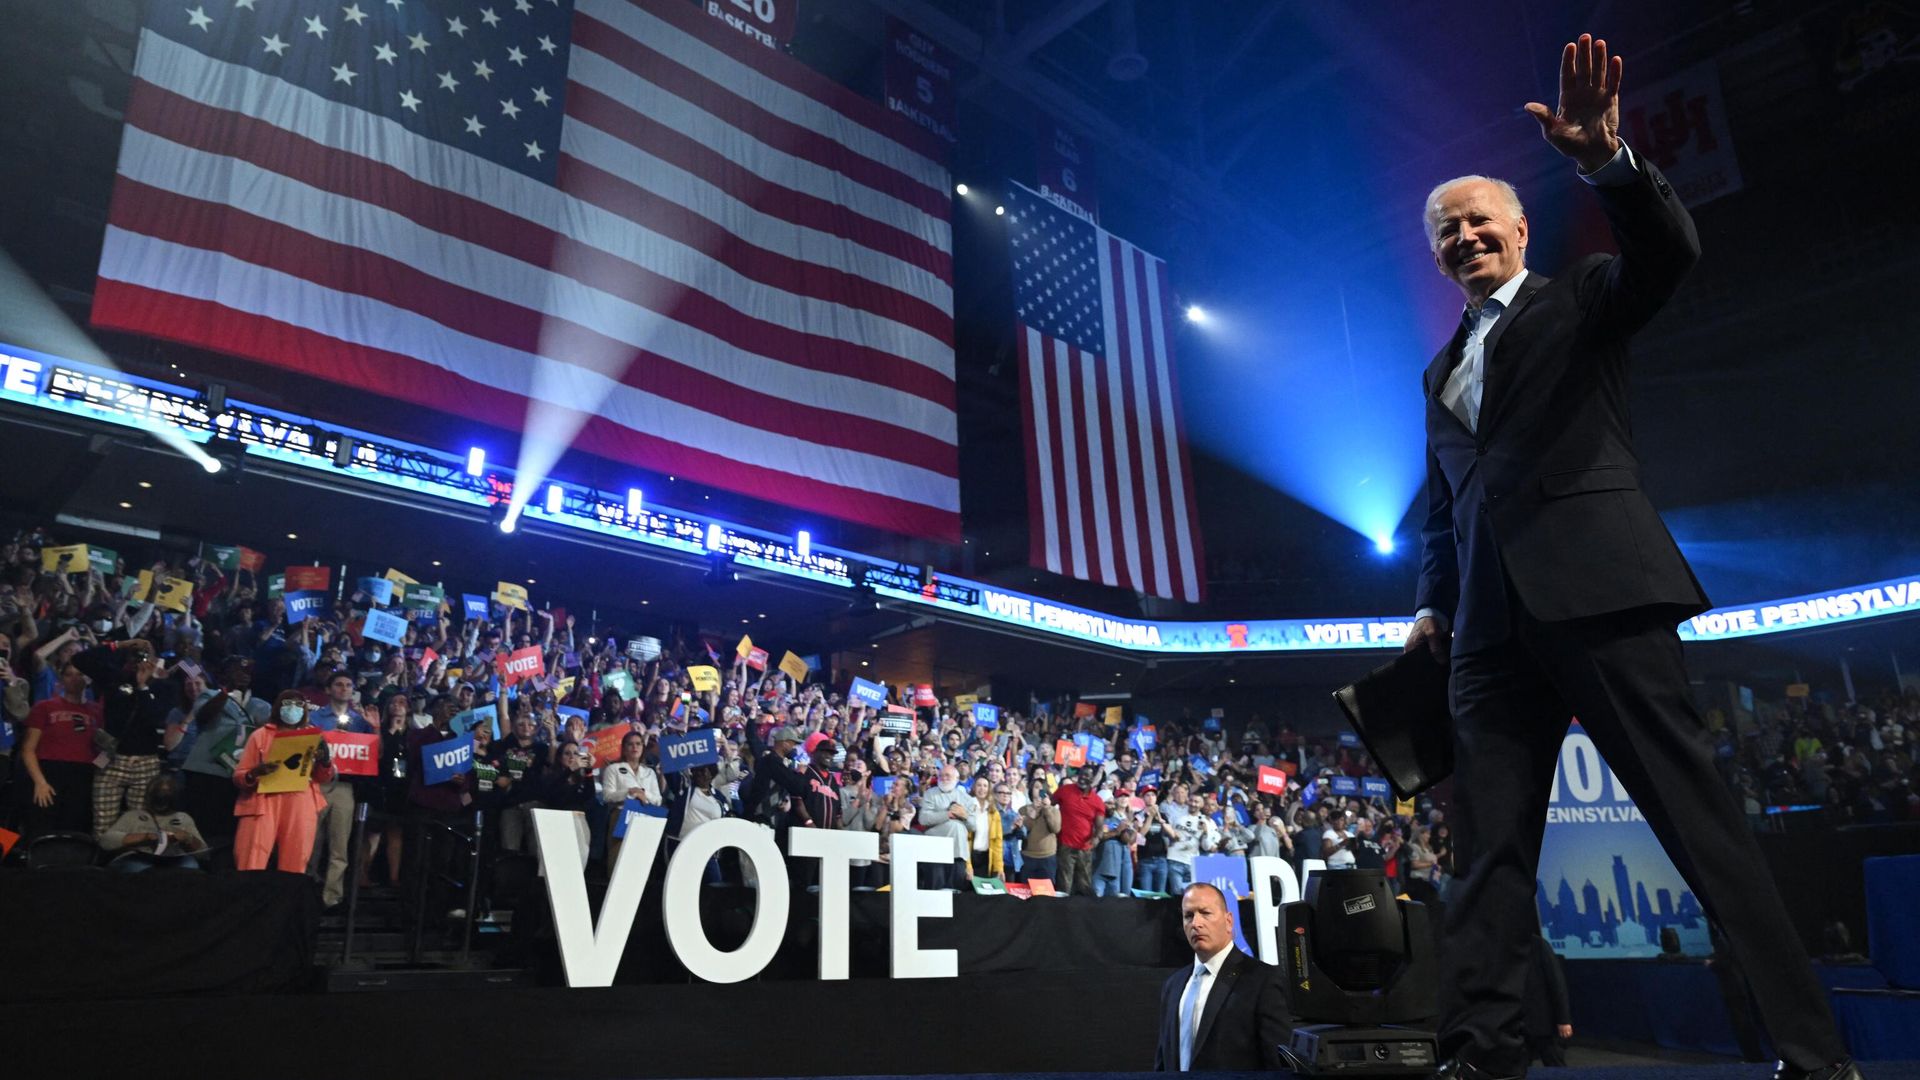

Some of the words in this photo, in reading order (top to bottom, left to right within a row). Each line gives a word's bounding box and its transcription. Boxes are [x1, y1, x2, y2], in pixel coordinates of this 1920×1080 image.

[917, 75, 933, 103] 5
[984, 590, 1031, 620] VOTE
[1034, 602, 1162, 646] PENNSYLVANIA
[1692, 610, 1757, 635] VOTE
[1304, 623, 1365, 643] VOTE
[505, 656, 538, 674] VOTE!
[856, 684, 881, 700] VOTE!
[977, 707, 996, 722] USA
[328, 743, 369, 760] VOTE!
[668, 739, 708, 758] VOTE!
[531, 808, 958, 988] VOTE
